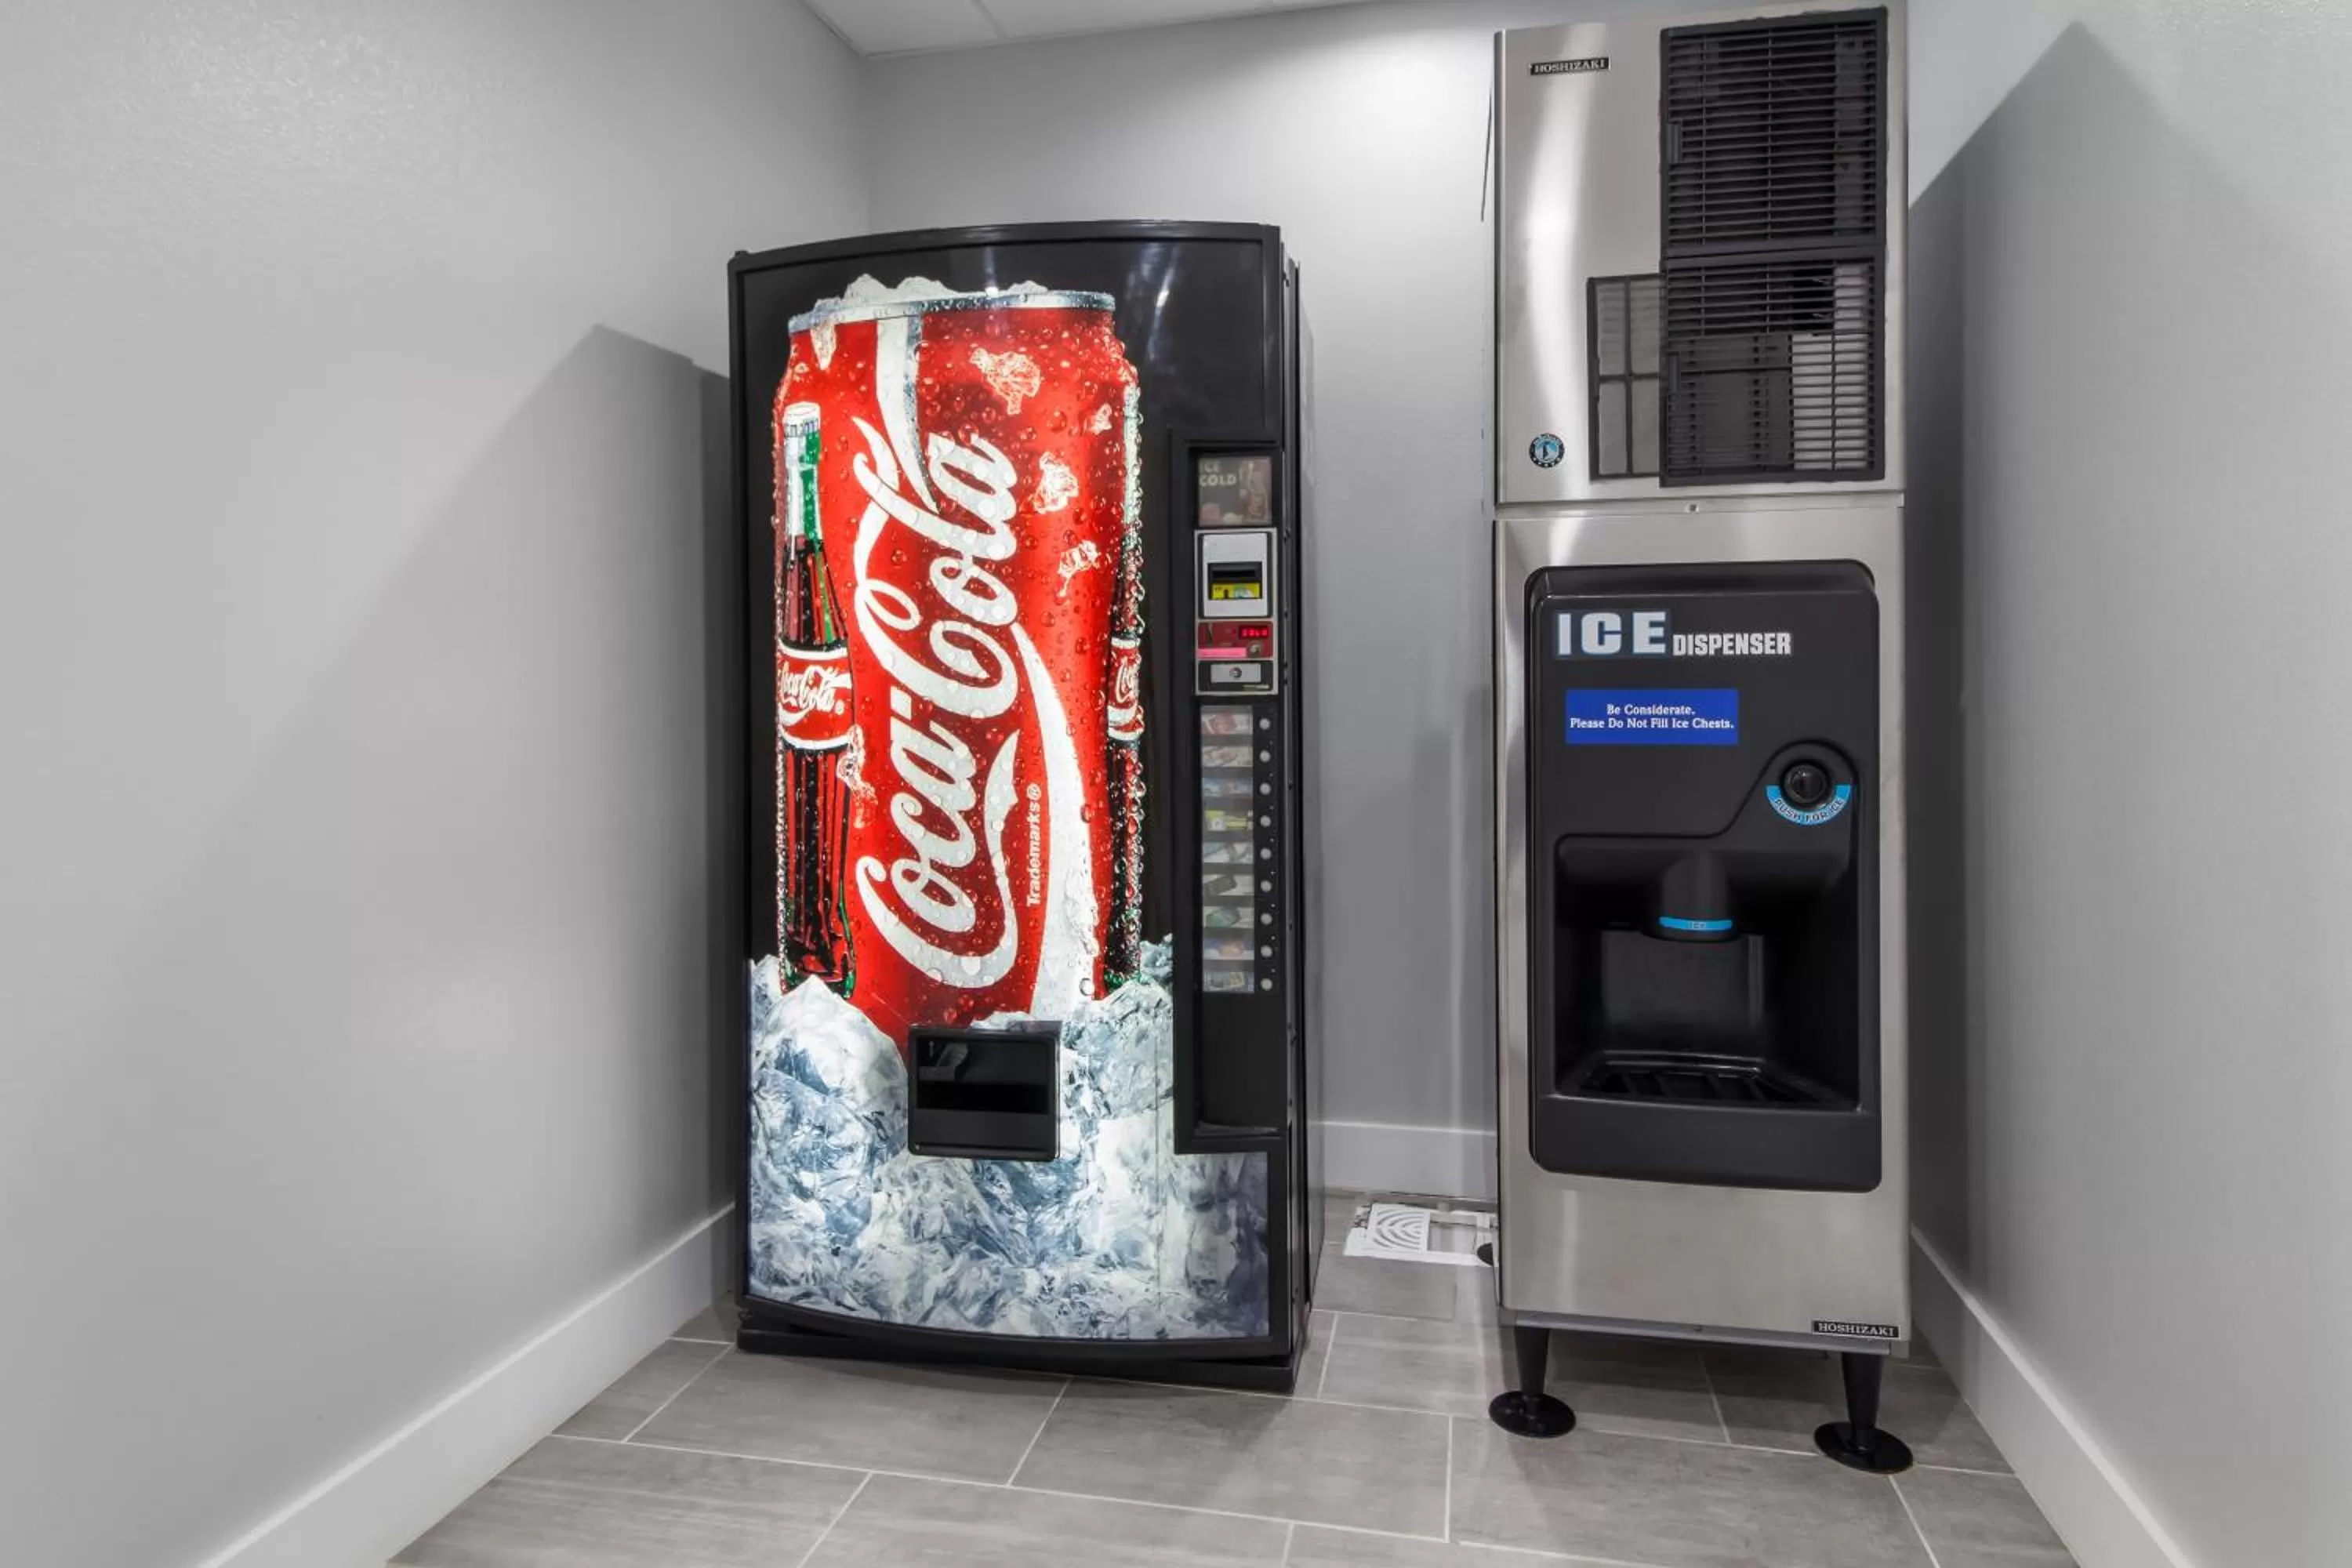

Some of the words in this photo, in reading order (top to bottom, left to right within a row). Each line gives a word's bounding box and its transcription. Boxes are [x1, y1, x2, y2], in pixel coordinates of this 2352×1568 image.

[1534, 59, 1606, 74] HOSHIZAKI
[1199, 474, 1237, 487] COLD
[1557, 611, 1667, 656] ICE
[1672, 632, 1792, 656] DISPENSER
[1606, 704, 1621, 716] Be
[1624, 704, 1696, 716] Considerate.
[1570, 717, 1605, 729] Please
[1608, 717, 1624, 729] Do
[1627, 717, 1647, 729] Not
[1650, 717, 1669, 729] Fill
[1671, 717, 1689, 729] Ice
[1692, 717, 1735, 729] Chests.
[1774, 797, 1802, 822] PUSH
[1806, 811, 1828, 822] FOR
[1828, 797, 1846, 813] ICE
[1818, 1322, 1895, 1337] HOSHIZAKI
